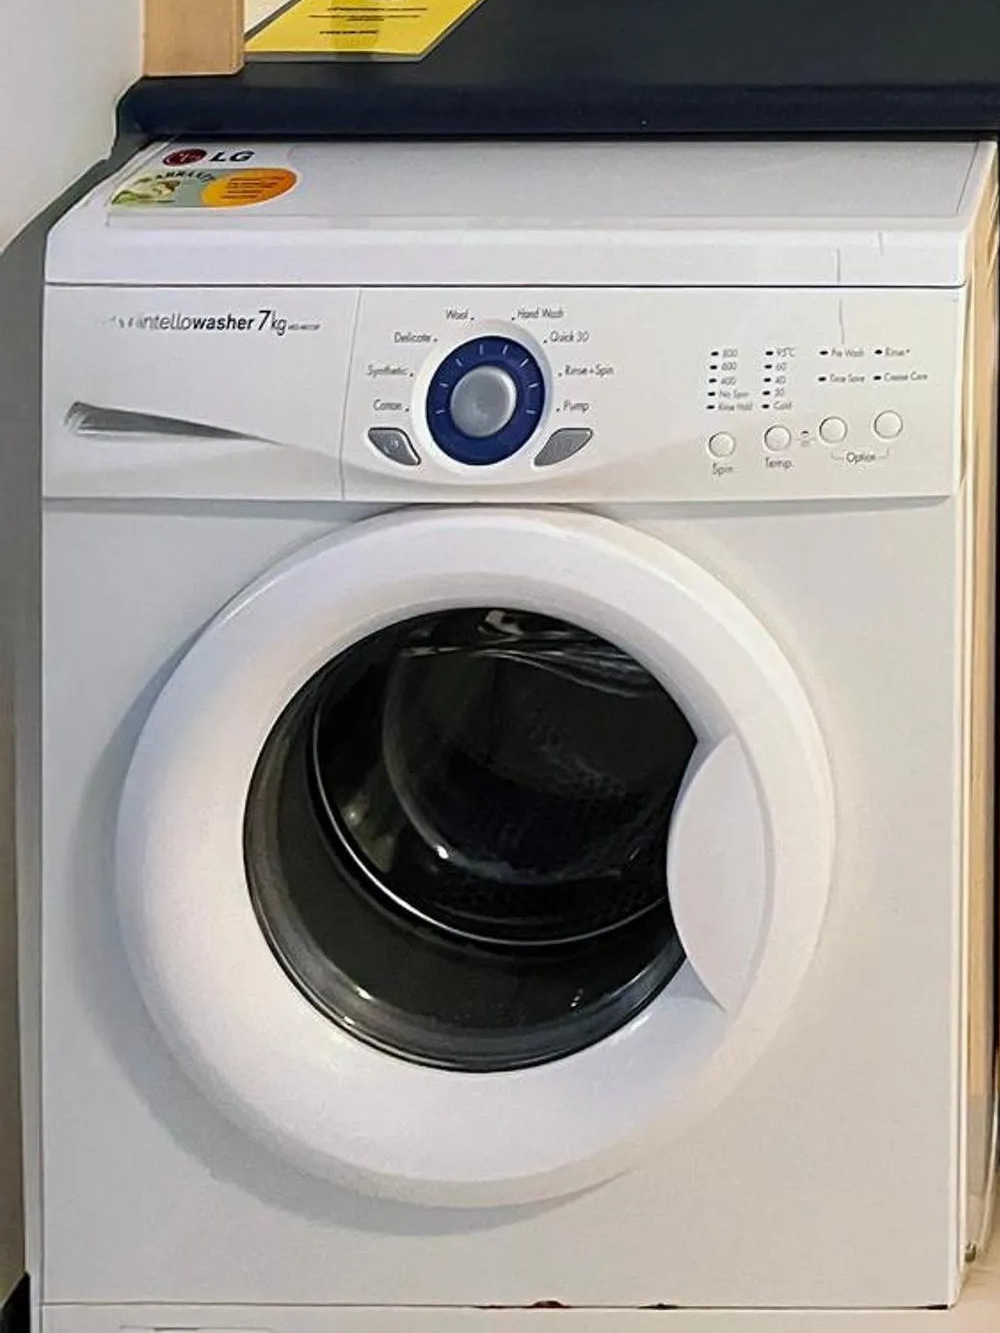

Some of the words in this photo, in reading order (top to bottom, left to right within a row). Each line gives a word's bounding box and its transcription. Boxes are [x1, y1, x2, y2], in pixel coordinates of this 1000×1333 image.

[209, 150, 255, 162] LG
[446, 309, 469, 320] Wool
[394, 331, 431, 343] Delicate
[550, 331, 575, 343] Quick
[562, 399, 590, 414] Pump
